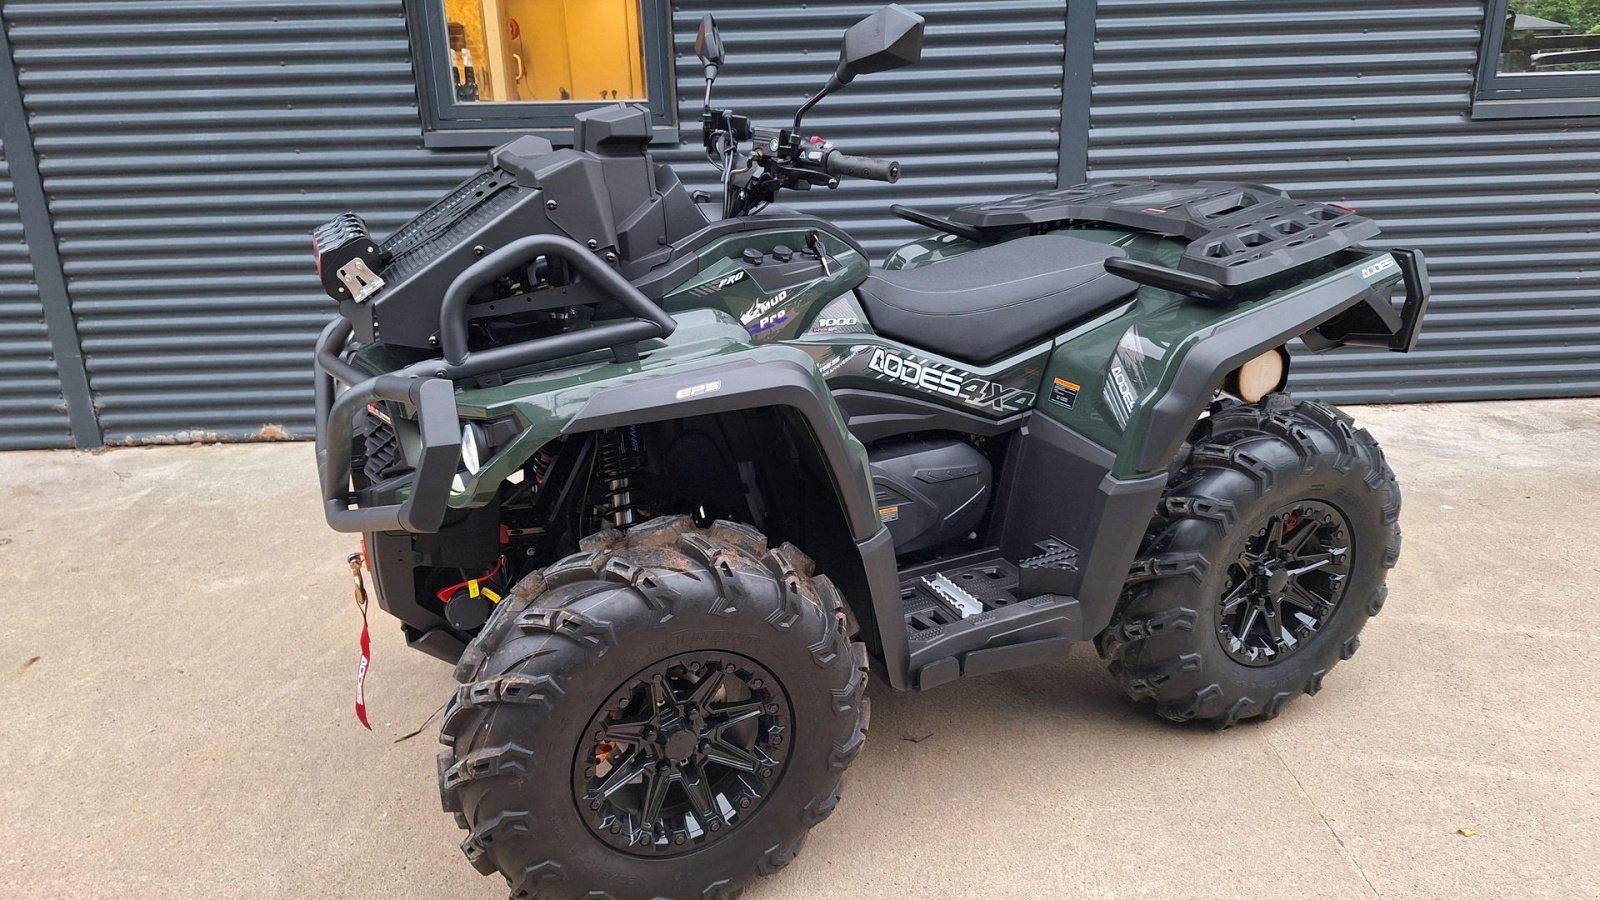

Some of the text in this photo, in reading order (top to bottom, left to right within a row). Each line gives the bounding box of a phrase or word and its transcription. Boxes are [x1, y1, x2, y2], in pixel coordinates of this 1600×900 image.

[1361, 257, 1394, 279] AODES
[718, 271, 745, 289] PRO
[760, 290, 788, 314] MUD
[759, 309, 786, 329] Pro
[819, 317, 857, 327] 1000
[868, 348, 964, 397] AODES
[676, 380, 722, 401] EPS
